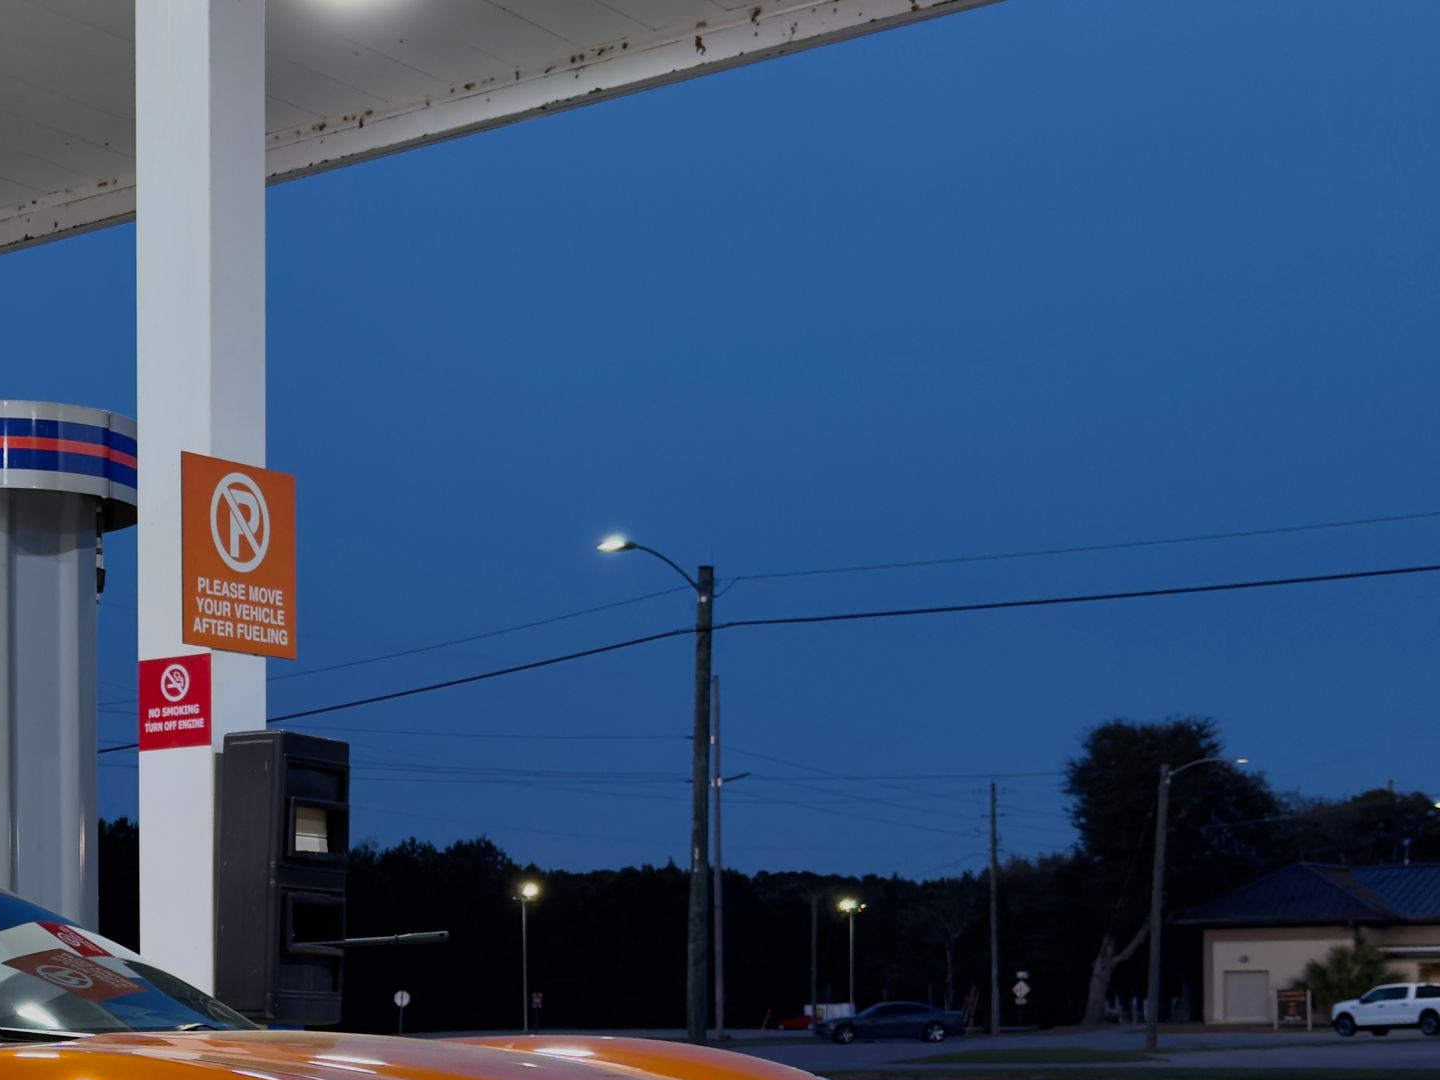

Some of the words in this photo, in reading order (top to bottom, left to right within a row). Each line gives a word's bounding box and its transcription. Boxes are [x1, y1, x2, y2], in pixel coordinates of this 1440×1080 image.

[197, 576, 246, 600] PLEASE
[249, 585, 283, 606] MOVE
[196, 597, 232, 617] YOUR
[234, 604, 285, 626] VEHICLE
[193, 617, 233, 638] AFTER
[236, 625, 288, 645] FUELING
[144, 720, 163, 733] TURN
[164, 719, 177, 731] OFF
[178, 717, 205, 730] ENGINE
[148, 707, 160, 718] NO
[162, 704, 199, 717] SMOKING
